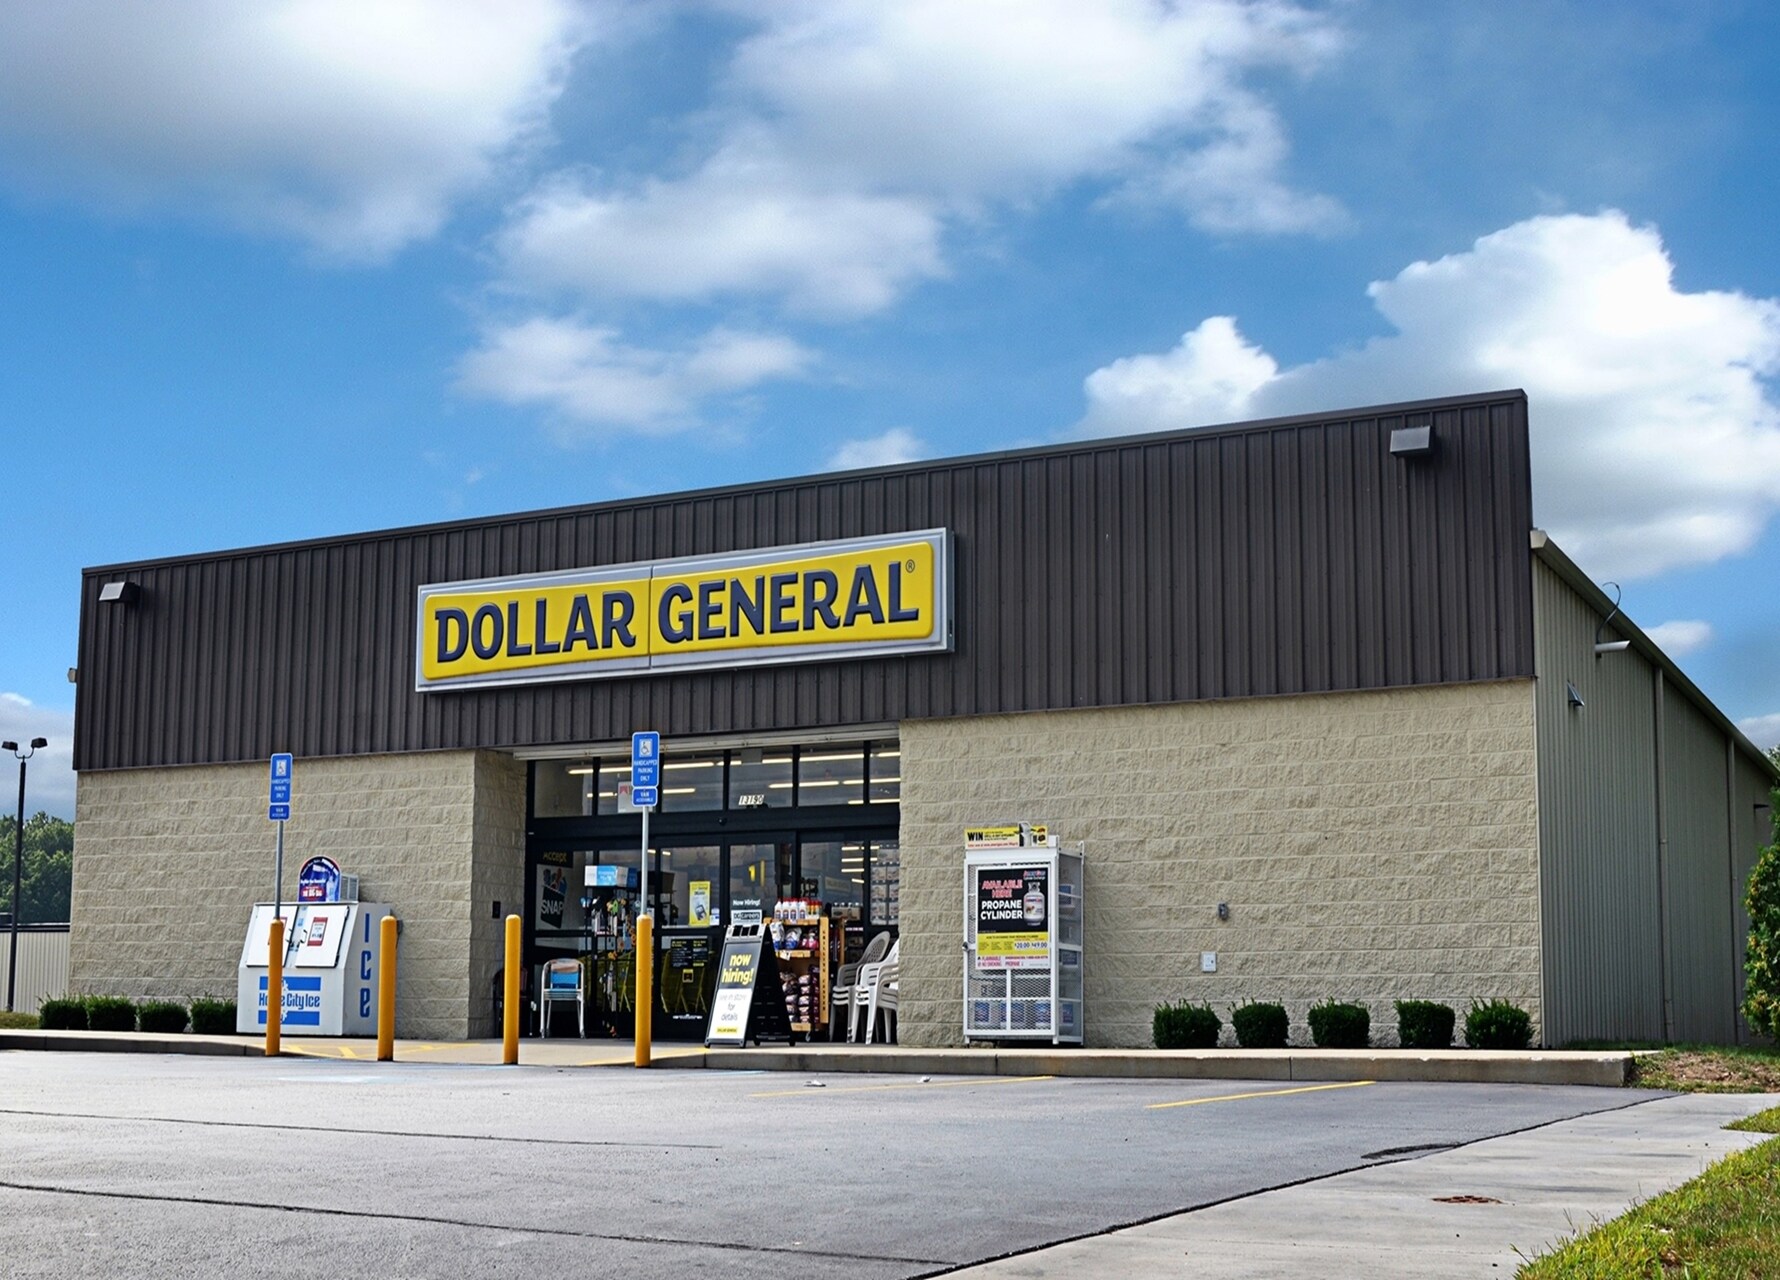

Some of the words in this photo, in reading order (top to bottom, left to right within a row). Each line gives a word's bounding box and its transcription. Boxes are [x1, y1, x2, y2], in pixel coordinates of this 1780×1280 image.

[435, 588, 637, 664] DOLLAR
[657, 560, 920, 644] GENERAL
[967, 832, 983, 841] WIN
[982, 880, 1023, 889] AVAILABLE
[541, 900, 565, 915] SNAP
[744, 899, 761, 907] Hiring!
[981, 900, 1023, 910] PROPANE
[980, 910, 1024, 920] CYLINDER
[730, 953, 752, 967] now
[721, 968, 754, 984] hiring!
[259, 993, 285, 1006] He
[286, 993, 304, 1010] City
[305, 995, 321, 1008] Ice
[728, 1003, 736, 1011] for
[721, 1012, 738, 1021] details
